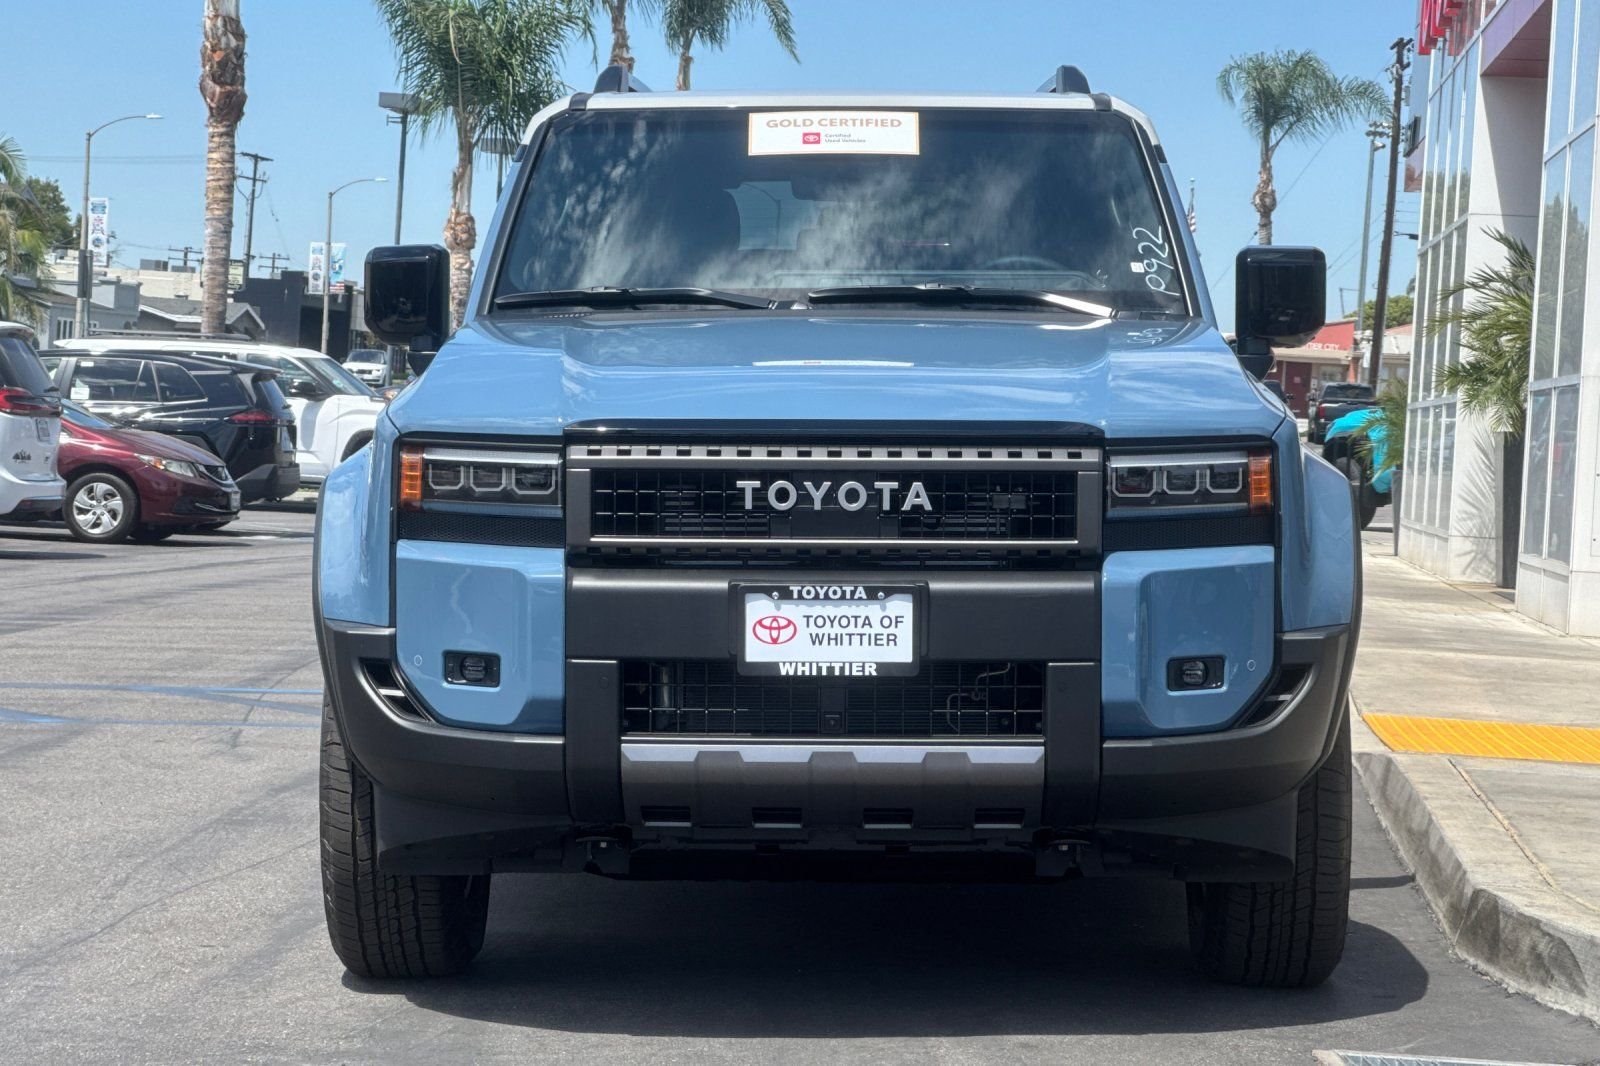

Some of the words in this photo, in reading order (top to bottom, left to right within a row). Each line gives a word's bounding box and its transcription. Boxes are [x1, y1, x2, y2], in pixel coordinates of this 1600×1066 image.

[766, 118, 814, 128] GOLD
[817, 118, 902, 128] CERTIFIED
[1133, 225, 1180, 296] 0922
[736, 480, 933, 512] TOYOTA
[789, 586, 867, 599] TOYOTA
[803, 615, 873, 629] TOYOTA
[879, 615, 905, 629] OF
[809, 633, 898, 647] WHITTIER
[779, 662, 877, 676] WHITTIER
